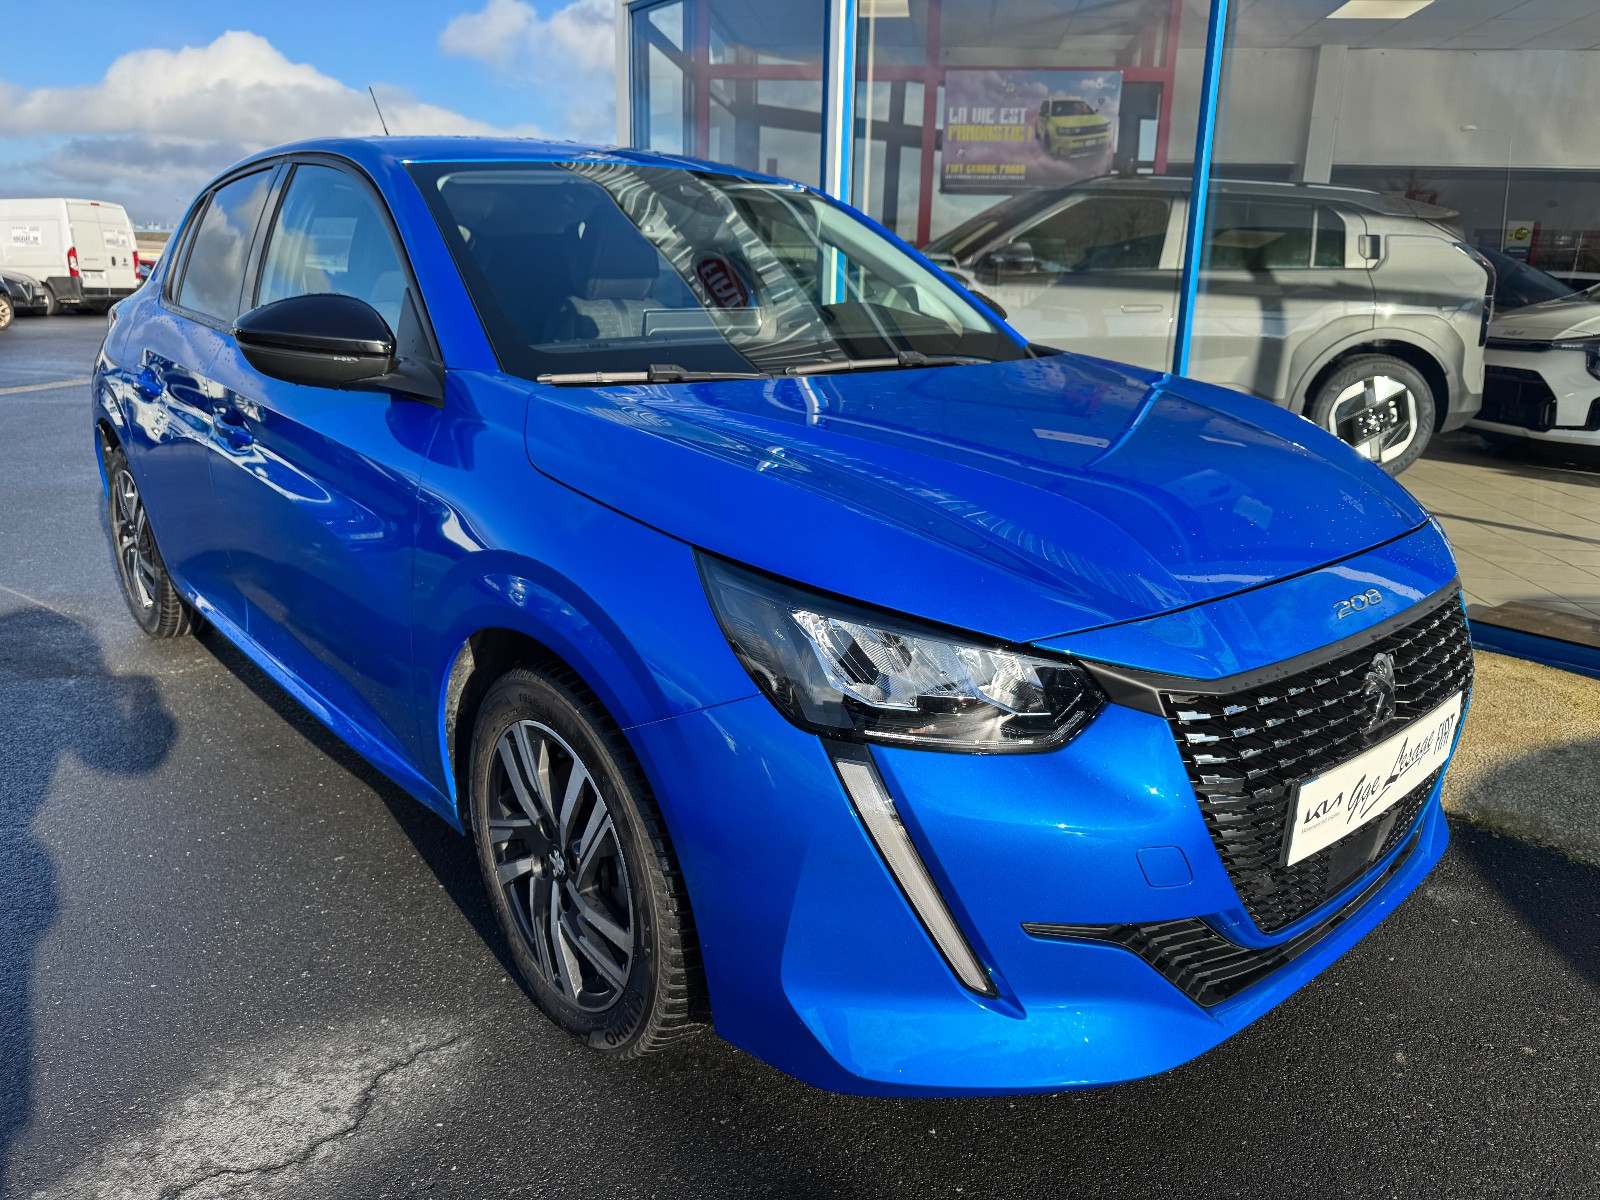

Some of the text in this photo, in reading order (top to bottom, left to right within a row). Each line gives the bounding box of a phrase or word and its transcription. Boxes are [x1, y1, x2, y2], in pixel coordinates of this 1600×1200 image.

[949, 107, 1027, 124] LA VIE EST
[1333, 588, 1382, 619] 208
[1382, 731, 1435, 790] Lesage
[1434, 713, 1456, 755] FIAT
